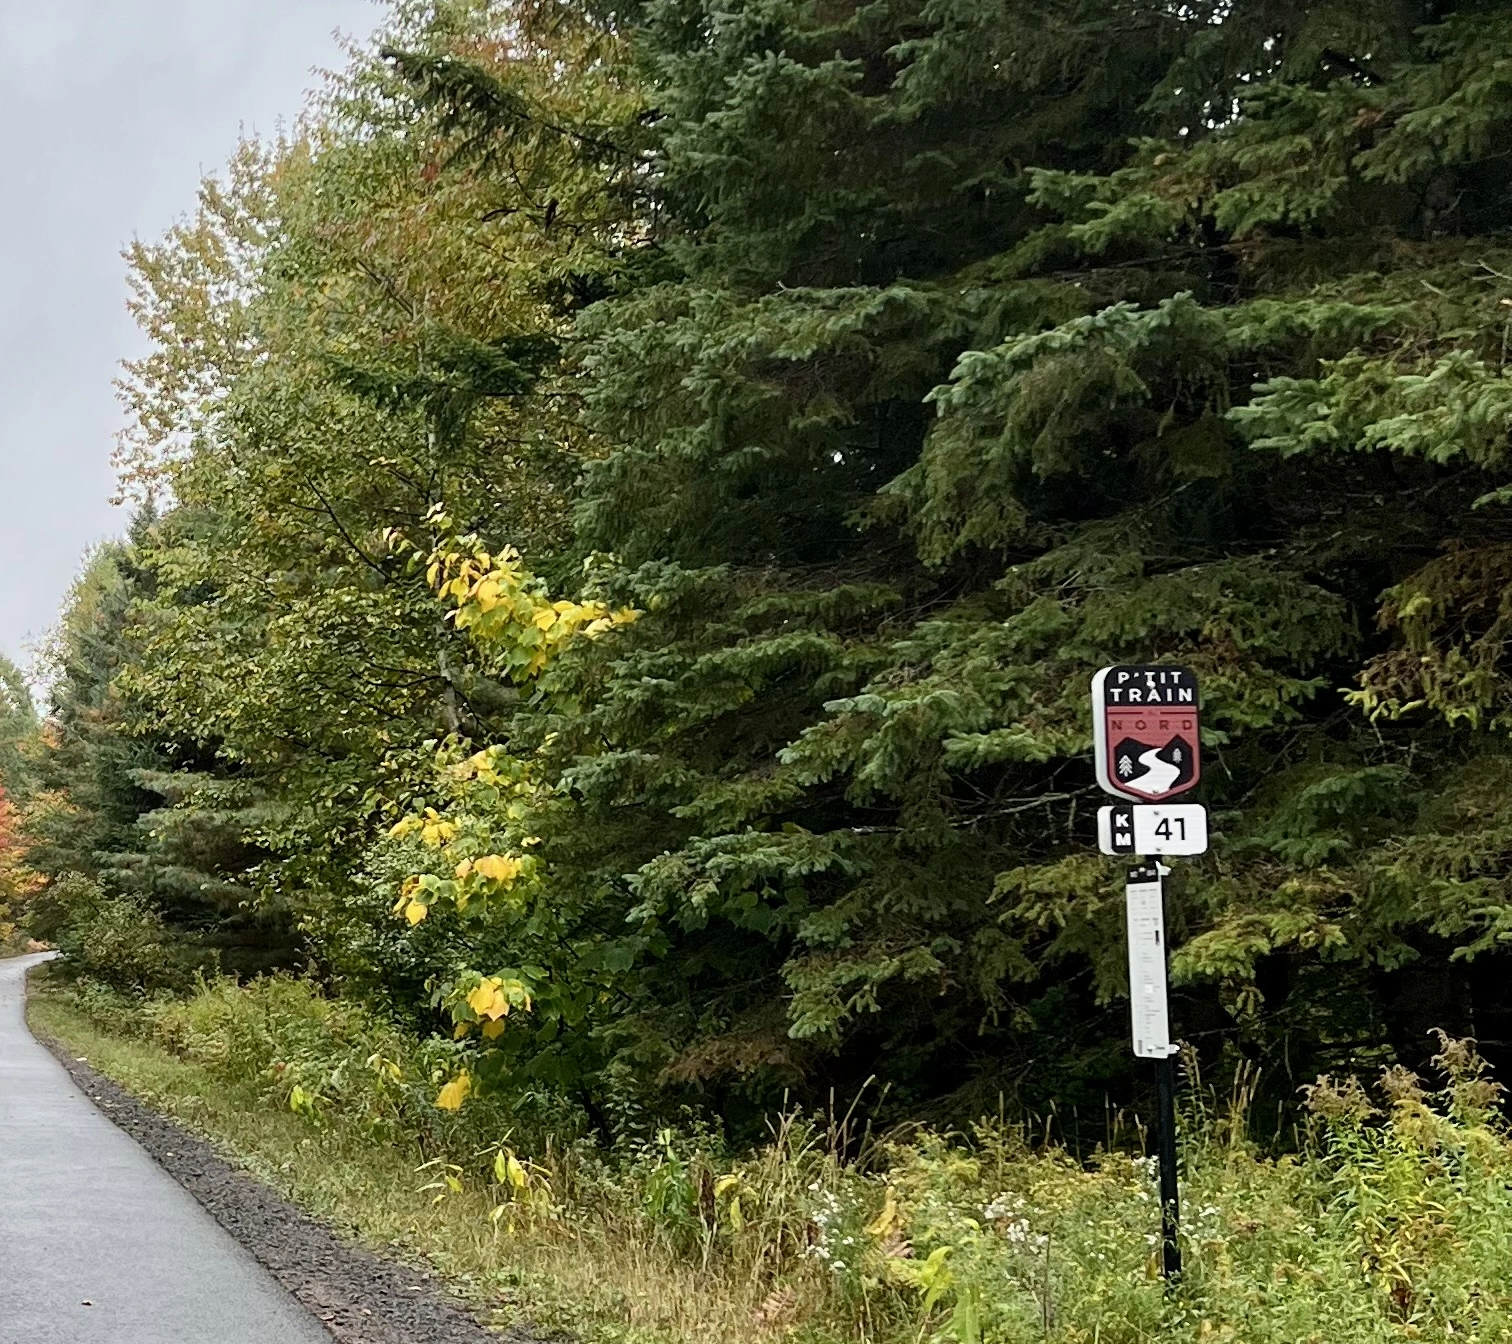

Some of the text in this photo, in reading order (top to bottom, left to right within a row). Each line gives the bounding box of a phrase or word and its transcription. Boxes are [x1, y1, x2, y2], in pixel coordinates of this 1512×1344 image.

[1117, 671, 1182, 685] P'TIT
[1109, 688, 1193, 703] TRAIN
[1111, 719, 1193, 731] NORD
[1115, 813, 1131, 846] KM
[1155, 817, 1186, 841] 41
